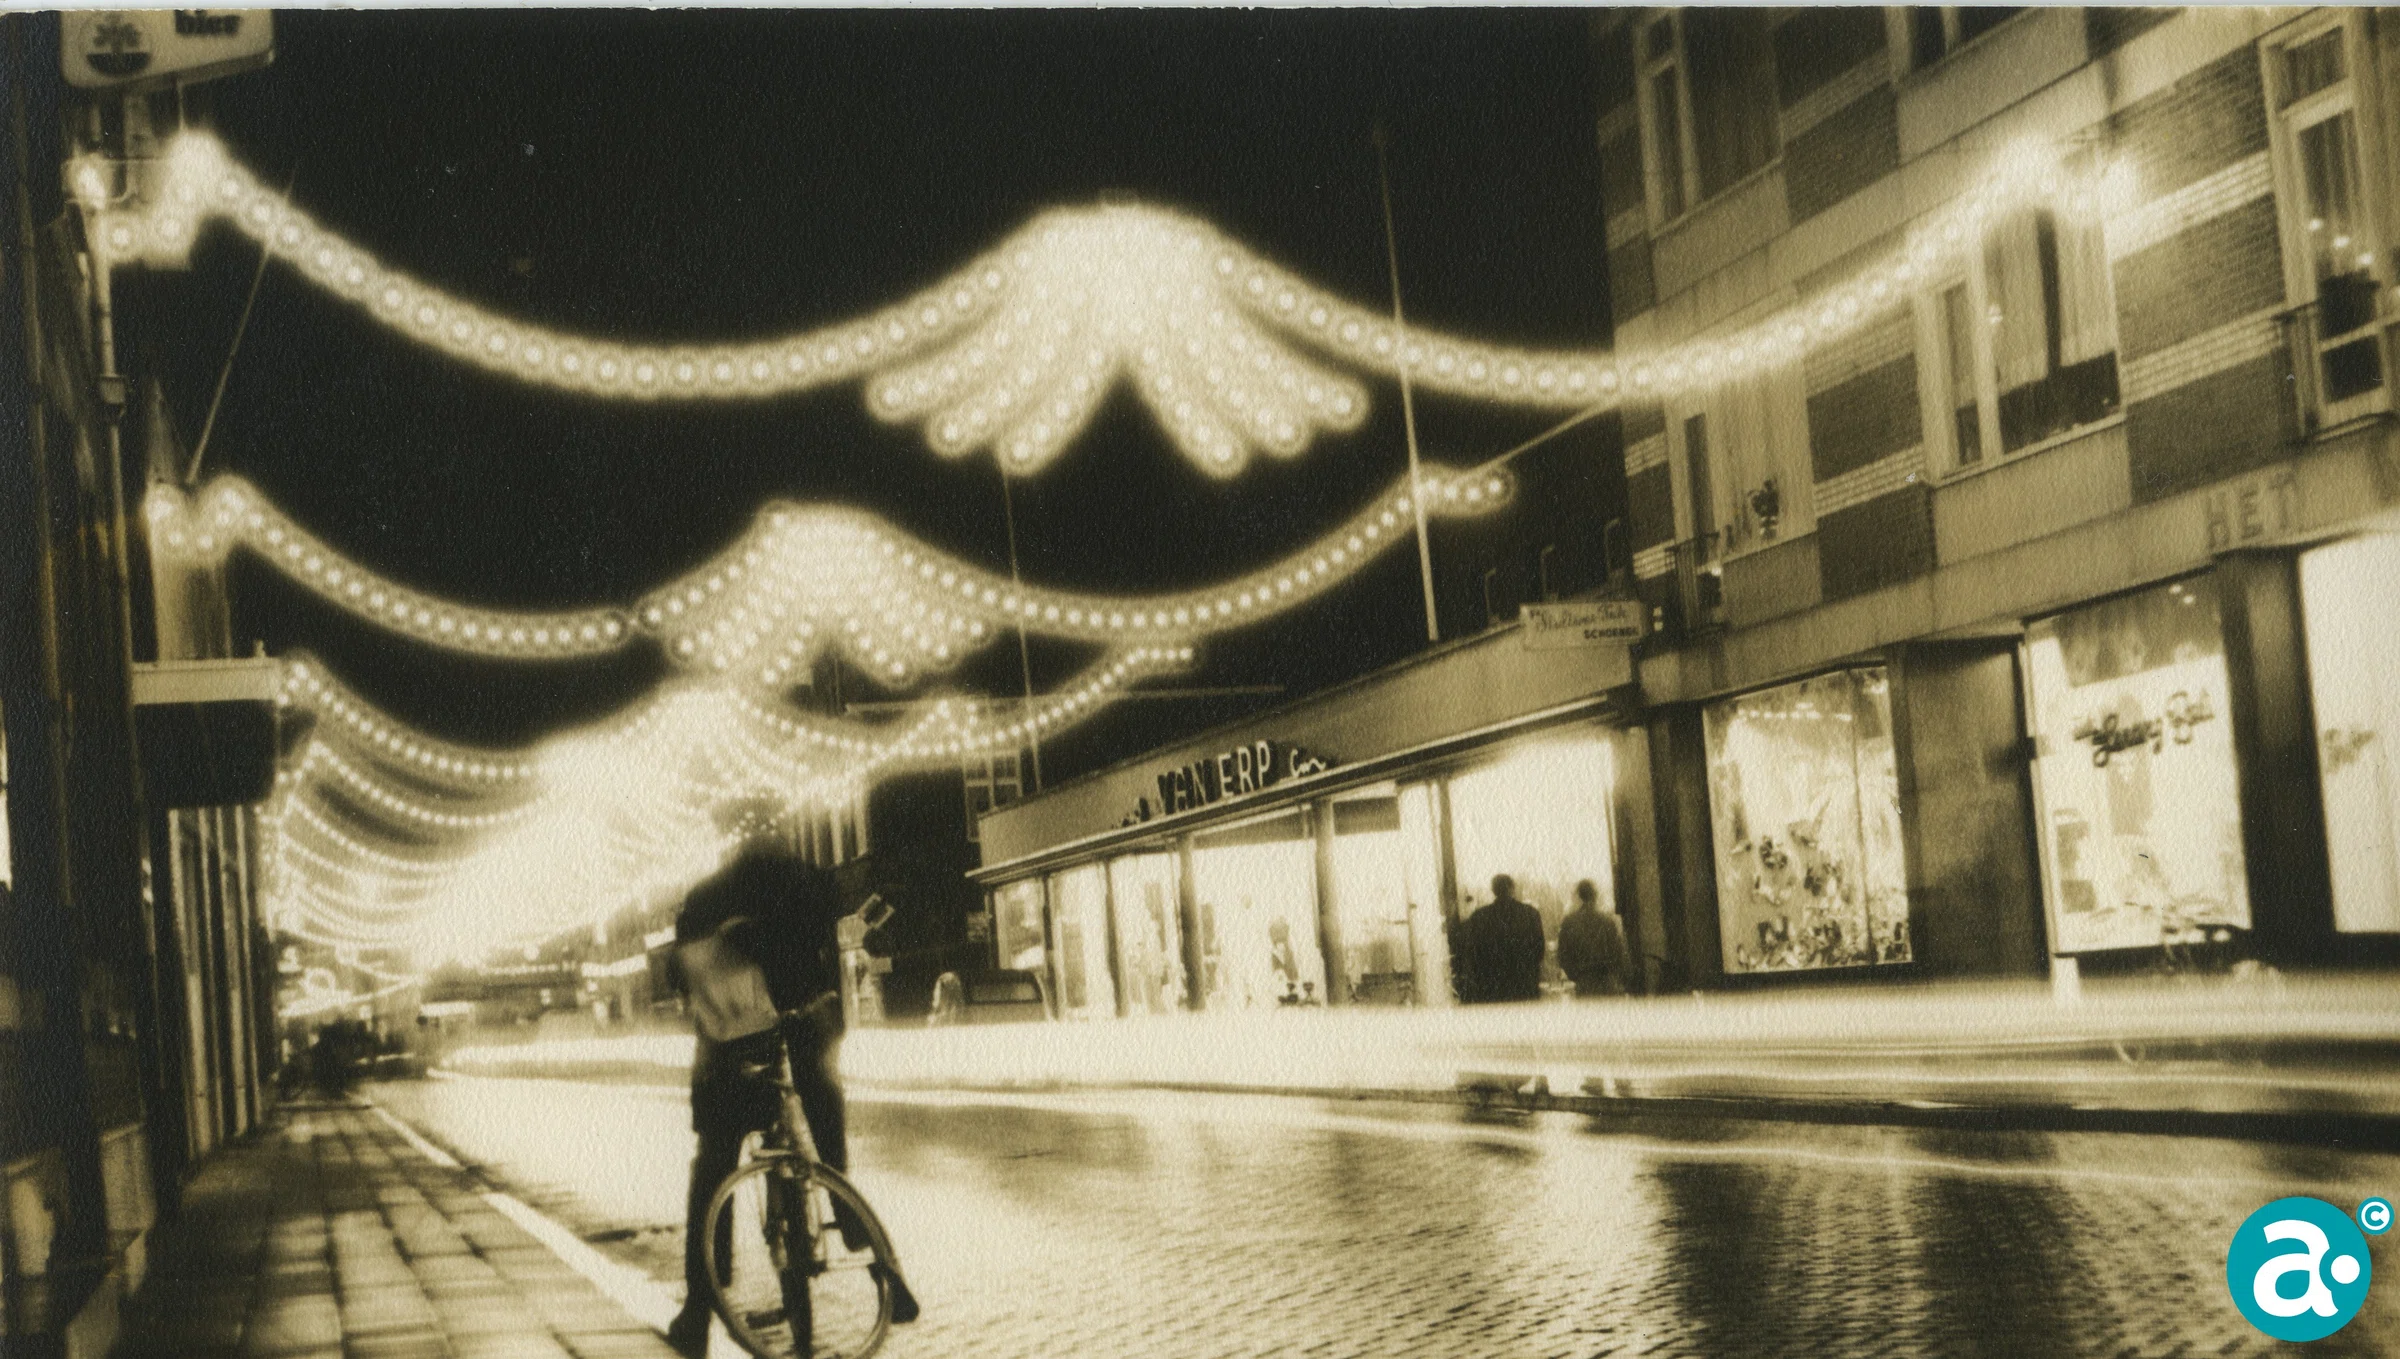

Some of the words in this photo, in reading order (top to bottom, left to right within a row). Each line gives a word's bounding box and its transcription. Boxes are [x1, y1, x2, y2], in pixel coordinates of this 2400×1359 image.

[174, 10, 242, 36] bier
[2206, 472, 2298, 549] HET
[1158, 758, 1218, 816] VAN
[1218, 740, 1272, 798] ERP
